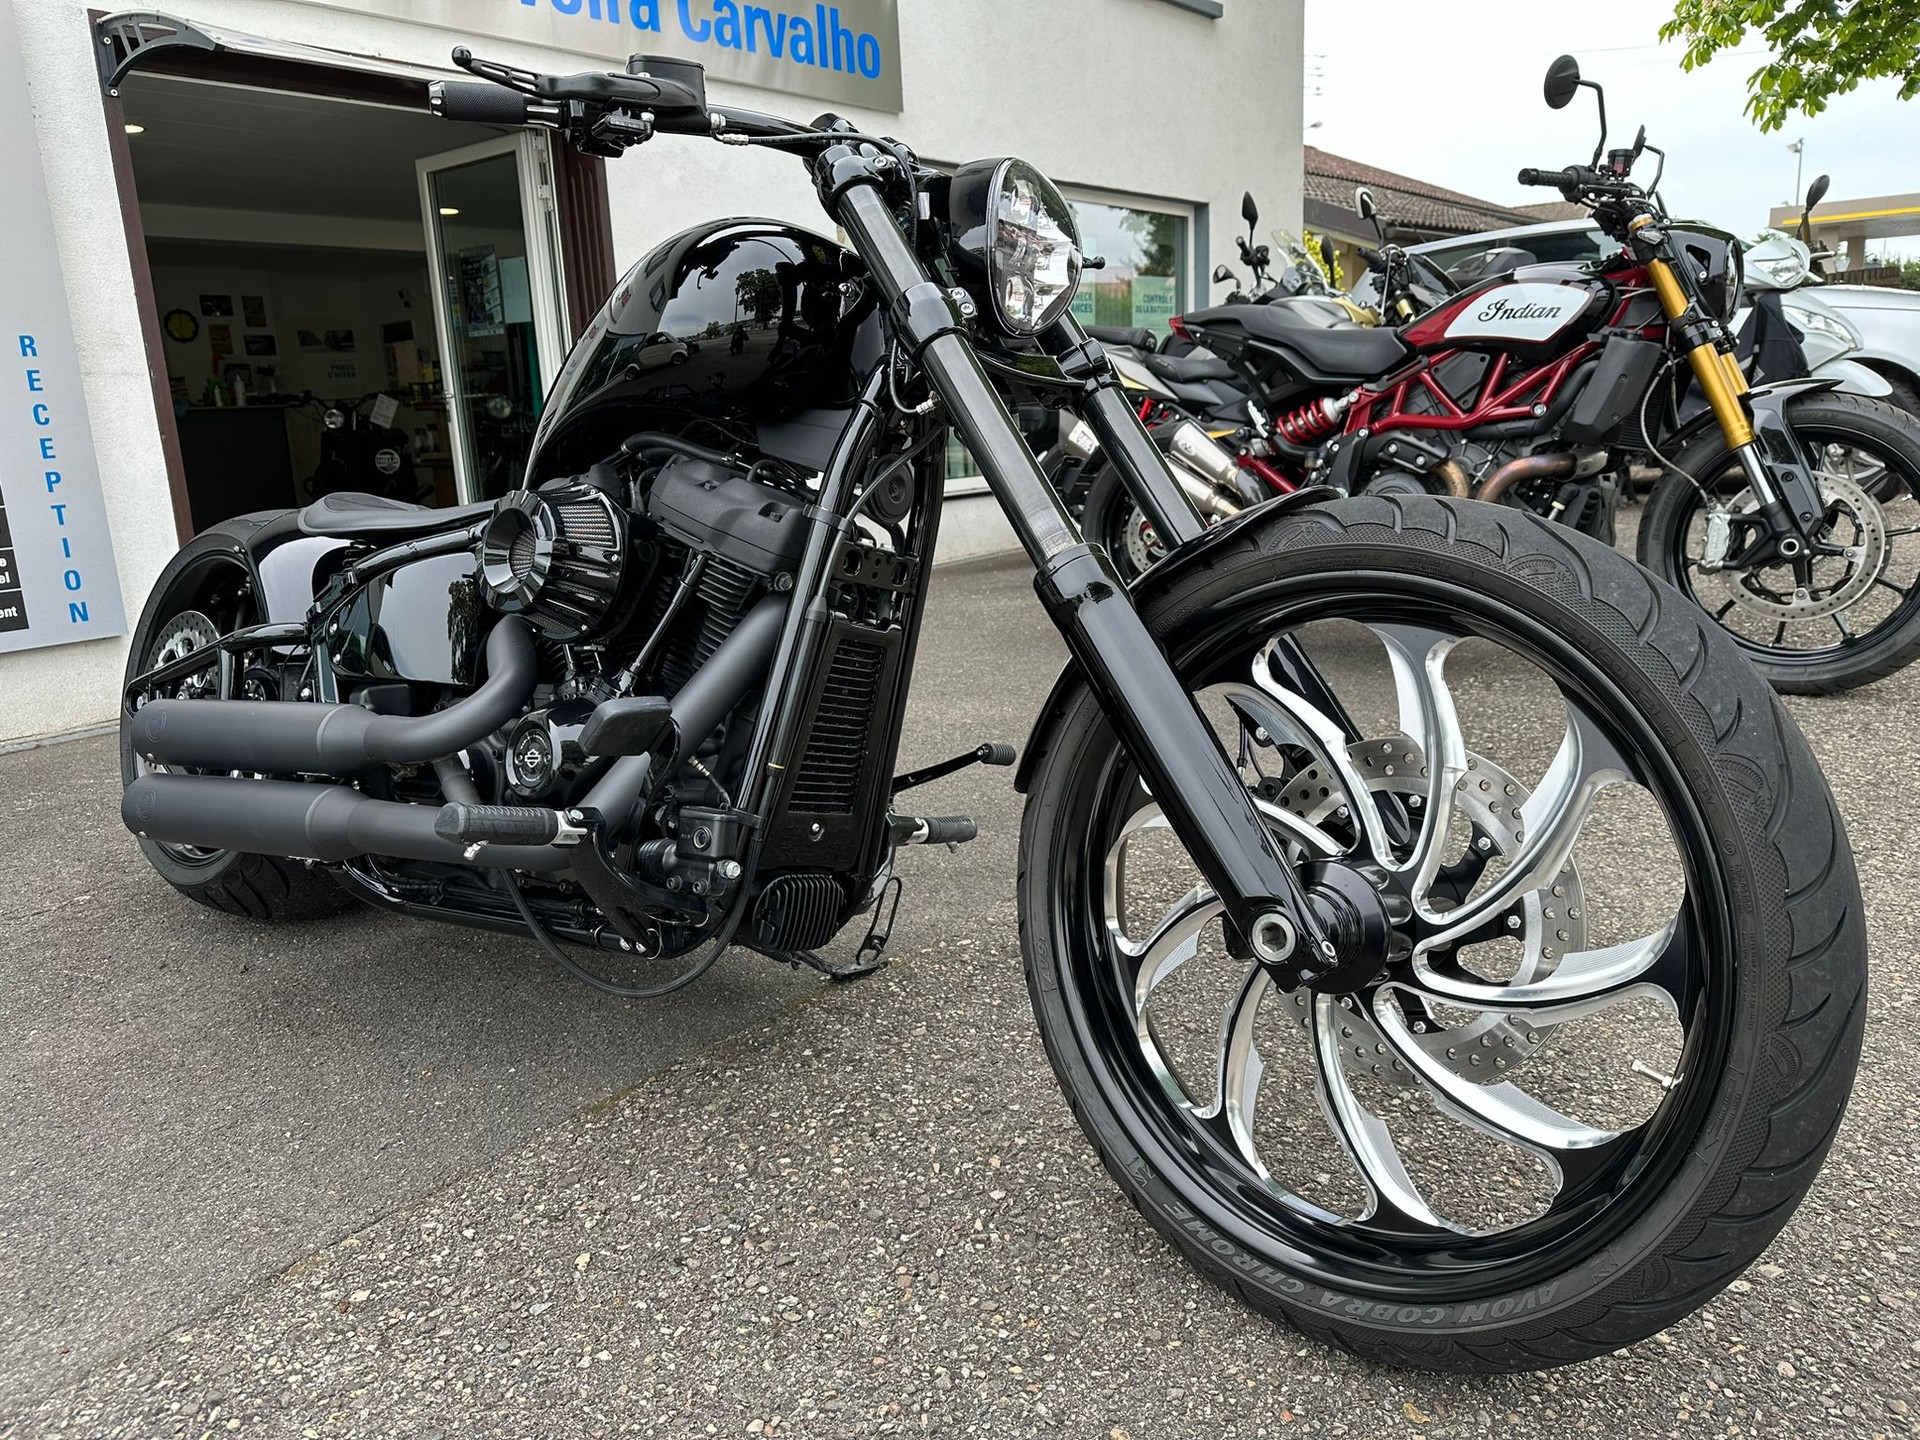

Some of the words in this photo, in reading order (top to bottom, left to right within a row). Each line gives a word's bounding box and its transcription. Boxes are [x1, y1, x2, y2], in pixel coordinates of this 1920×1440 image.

[677, 0, 881, 79] Carvalho
[1071, 302, 1093, 314] ANCES
[1478, 299, 1561, 322] Indian
[19, 335, 89, 624] RECEPTION
[1163, 1202, 1305, 1294] CHROME
[1319, 1290, 1446, 1325] COBRA
[1458, 1281, 1560, 1323] AVON
